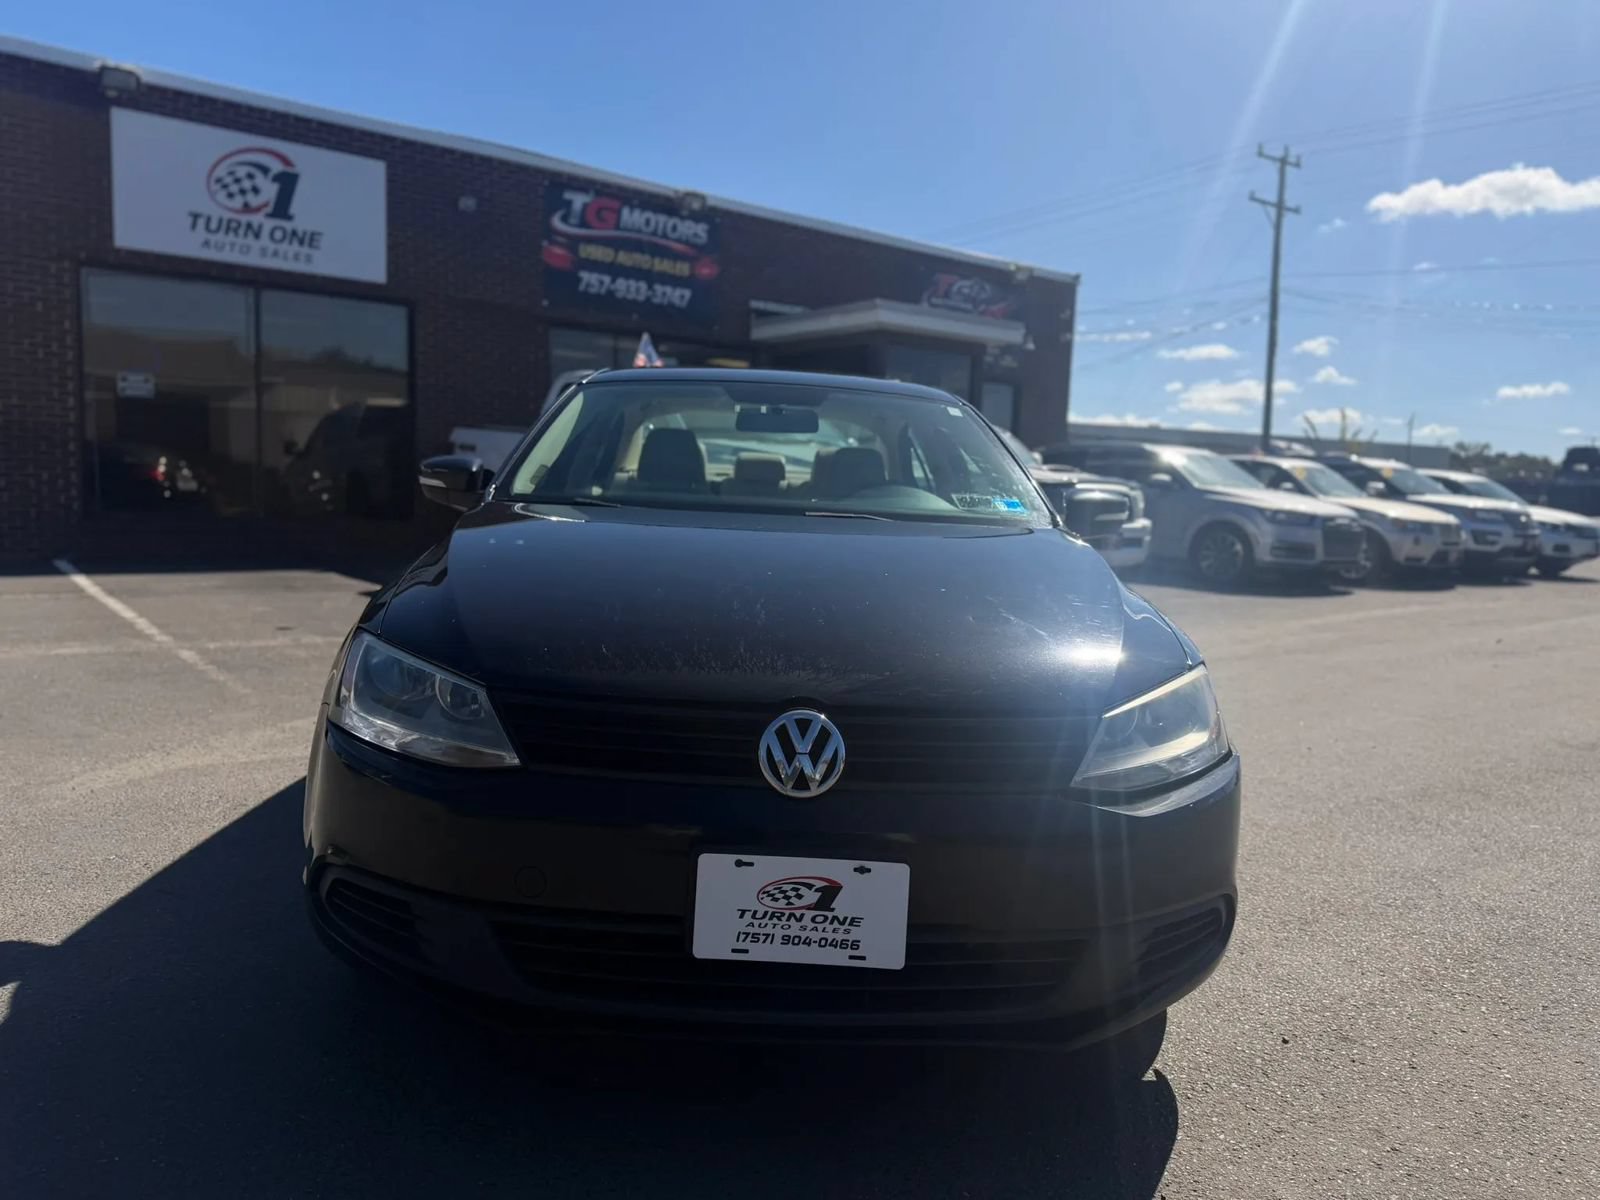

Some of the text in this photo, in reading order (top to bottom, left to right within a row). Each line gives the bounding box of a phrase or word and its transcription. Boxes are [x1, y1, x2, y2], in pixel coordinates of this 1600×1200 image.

[562, 190, 709, 245] TG MOTORS
[188, 211, 323, 250] TURN ONE
[201, 238, 314, 265] AUTO SALES
[736, 909, 864, 928] TURN ONE
[745, 922, 852, 935] AUTO SALES
[780, 934, 861, 950] 904-0466
